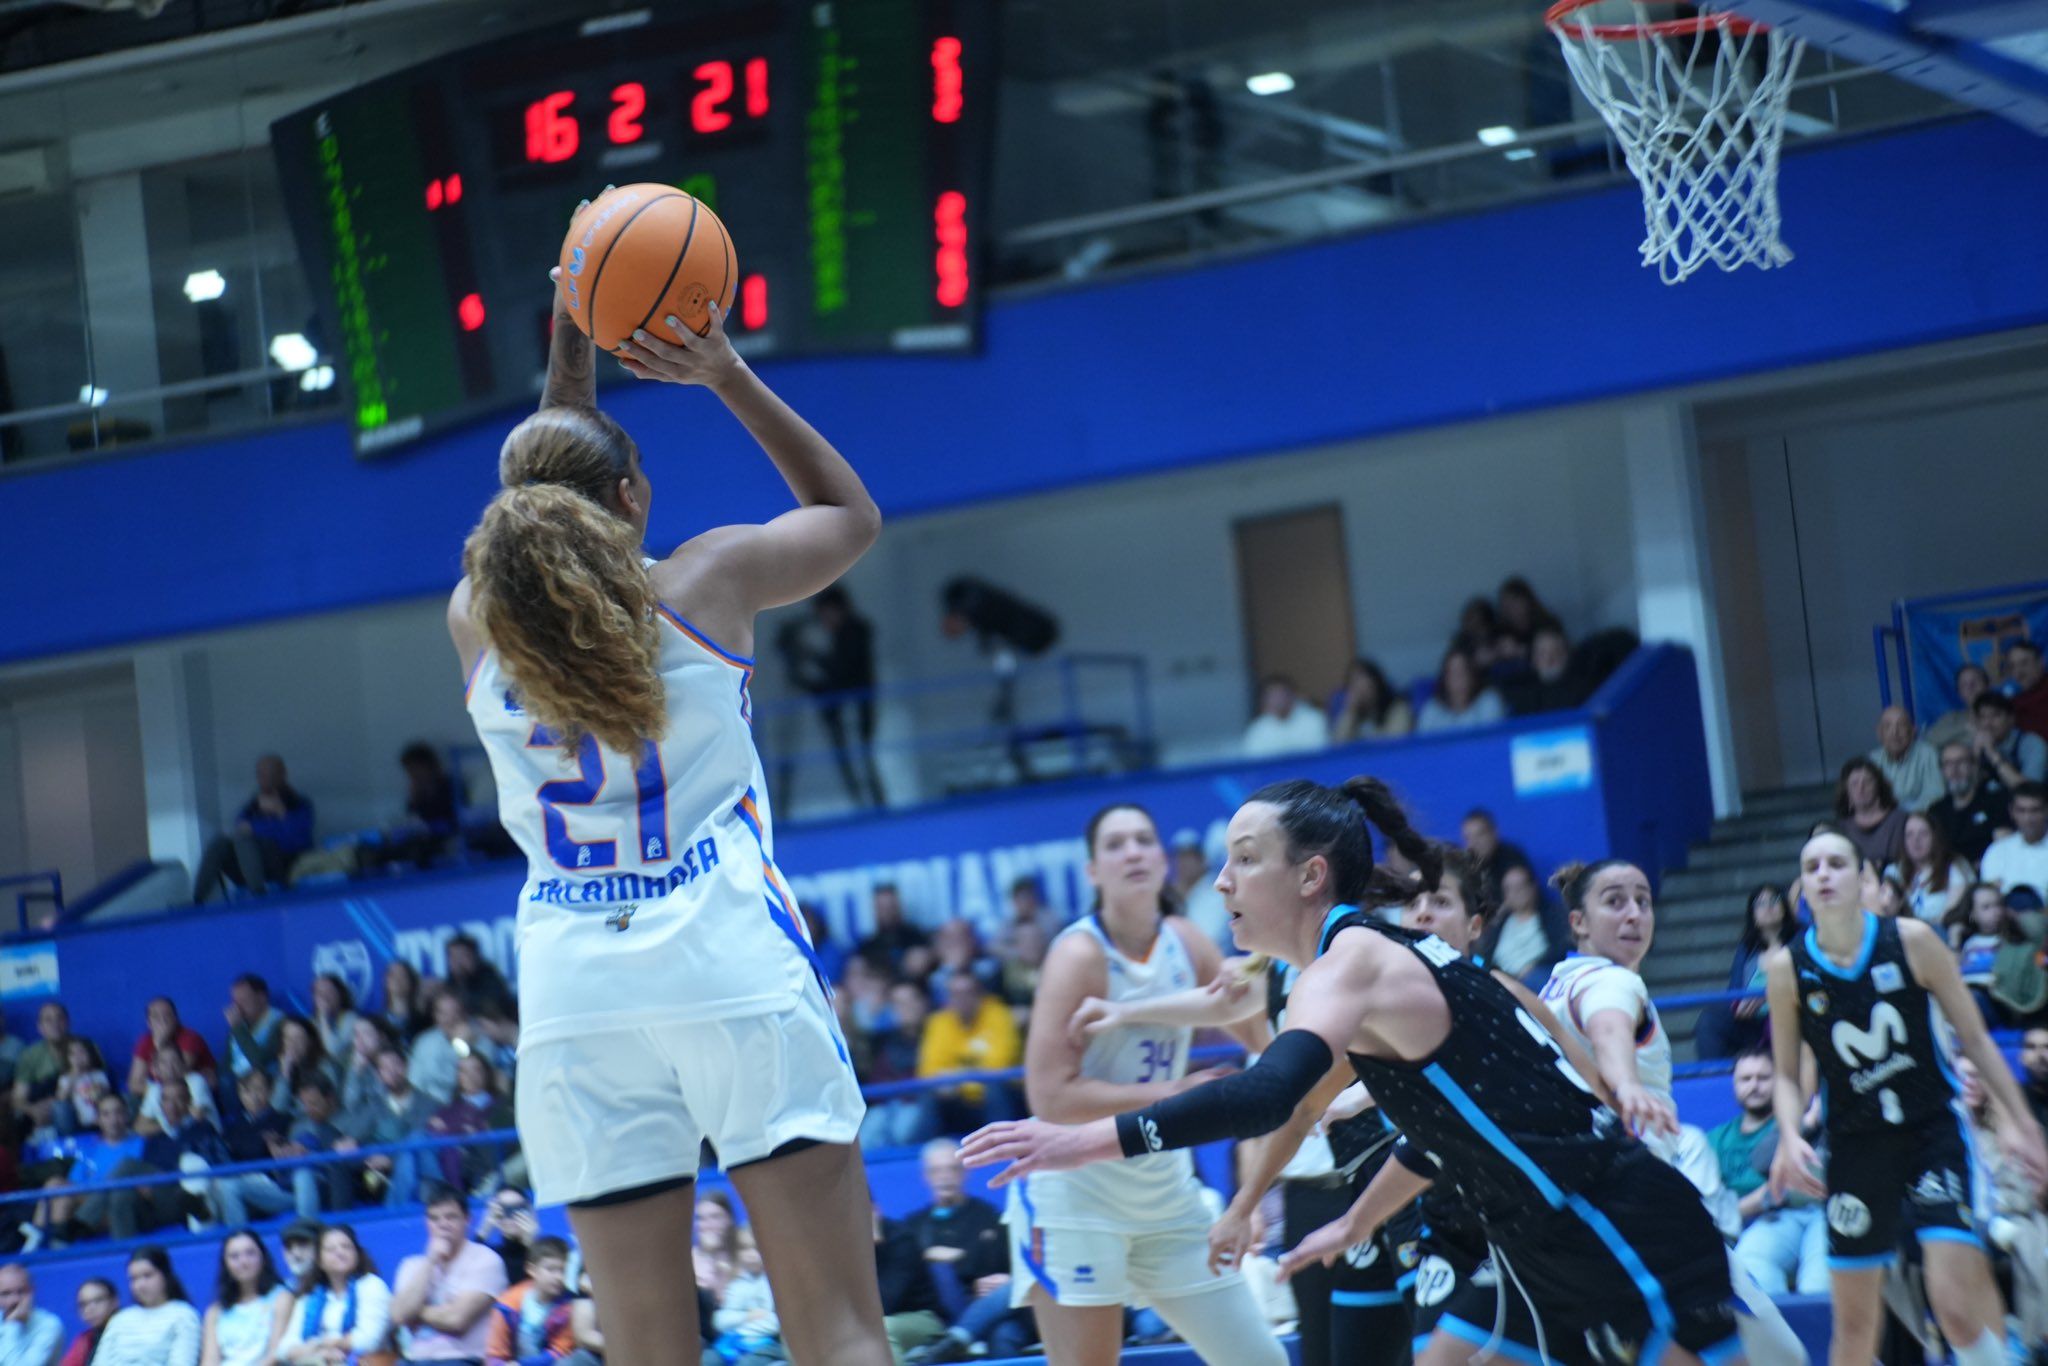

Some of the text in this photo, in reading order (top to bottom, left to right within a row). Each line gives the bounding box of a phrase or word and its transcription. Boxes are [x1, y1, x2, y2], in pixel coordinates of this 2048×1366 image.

[525, 57, 769, 163] 16 2 21
[526, 722, 671, 870] 21
[1136, 1039, 1177, 1083] 34
